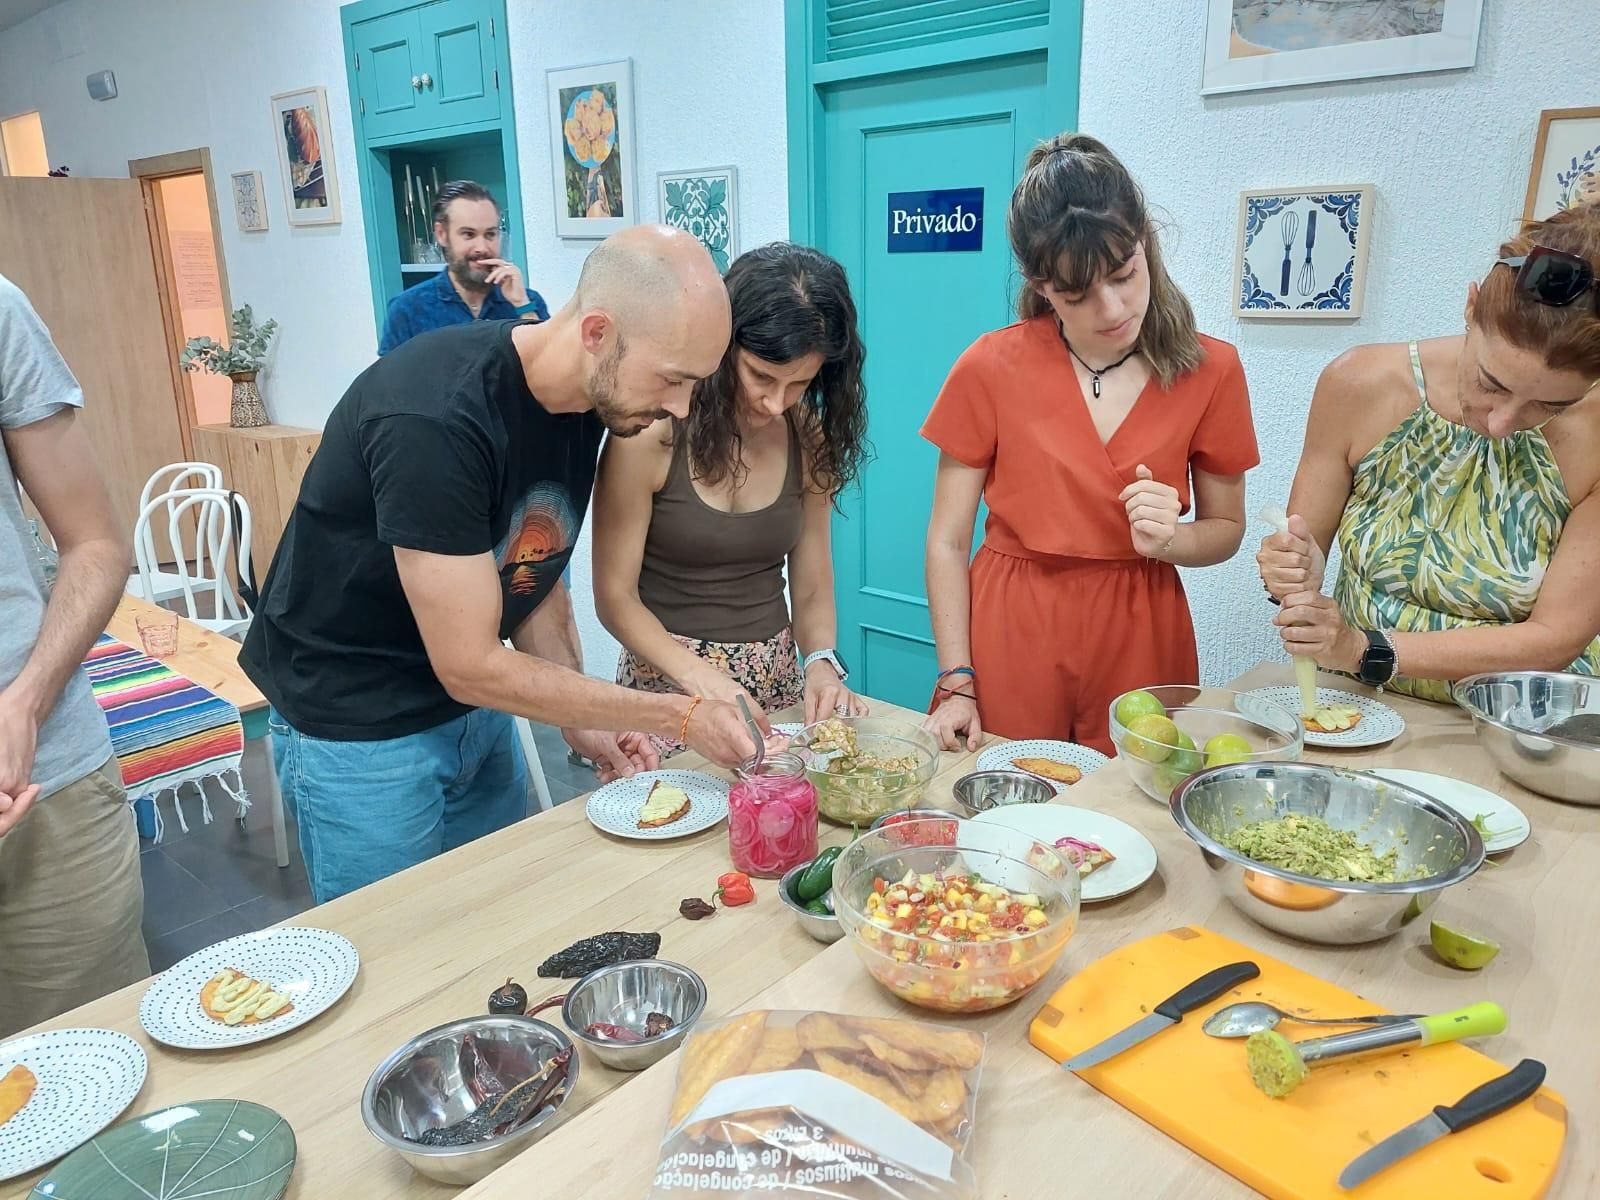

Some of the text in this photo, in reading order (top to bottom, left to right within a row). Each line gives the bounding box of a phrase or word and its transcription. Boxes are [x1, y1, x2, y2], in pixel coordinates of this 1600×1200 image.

[893, 204, 977, 234] Privado
[813, 1125, 825, 1141] 3
[761, 1149, 782, 1169] de
